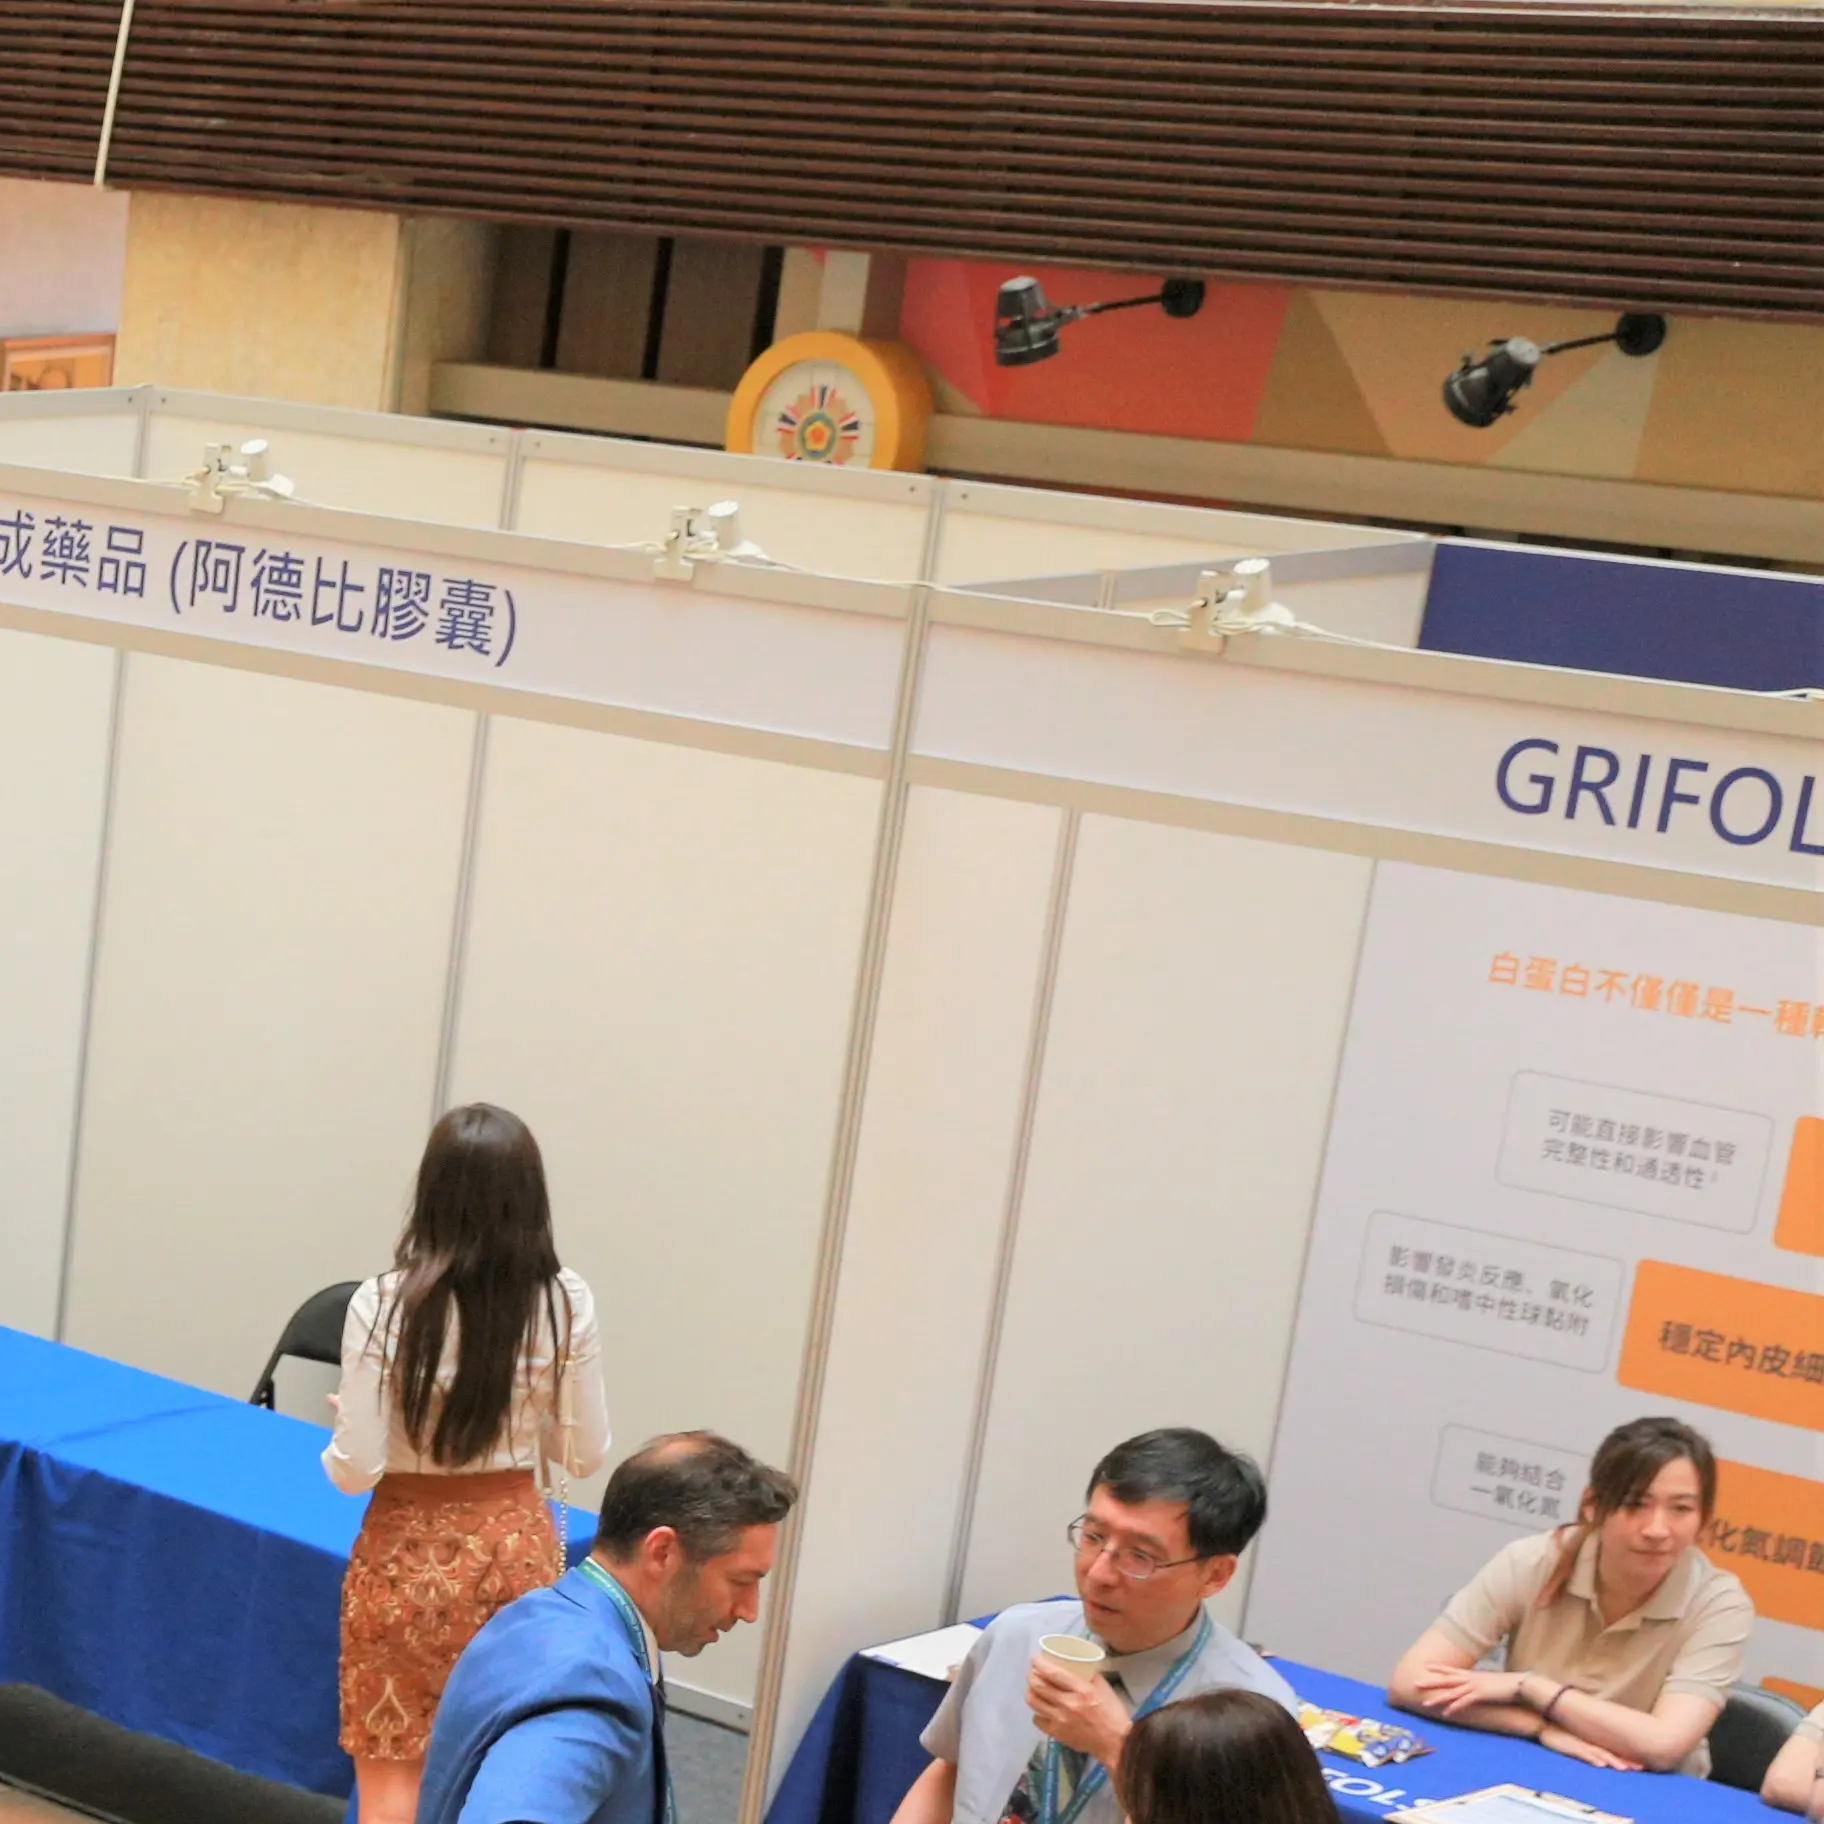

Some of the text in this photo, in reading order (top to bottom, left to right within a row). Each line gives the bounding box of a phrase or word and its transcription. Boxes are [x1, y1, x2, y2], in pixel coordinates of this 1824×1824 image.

[169, 538, 518, 668] (阿德比膠囊)
